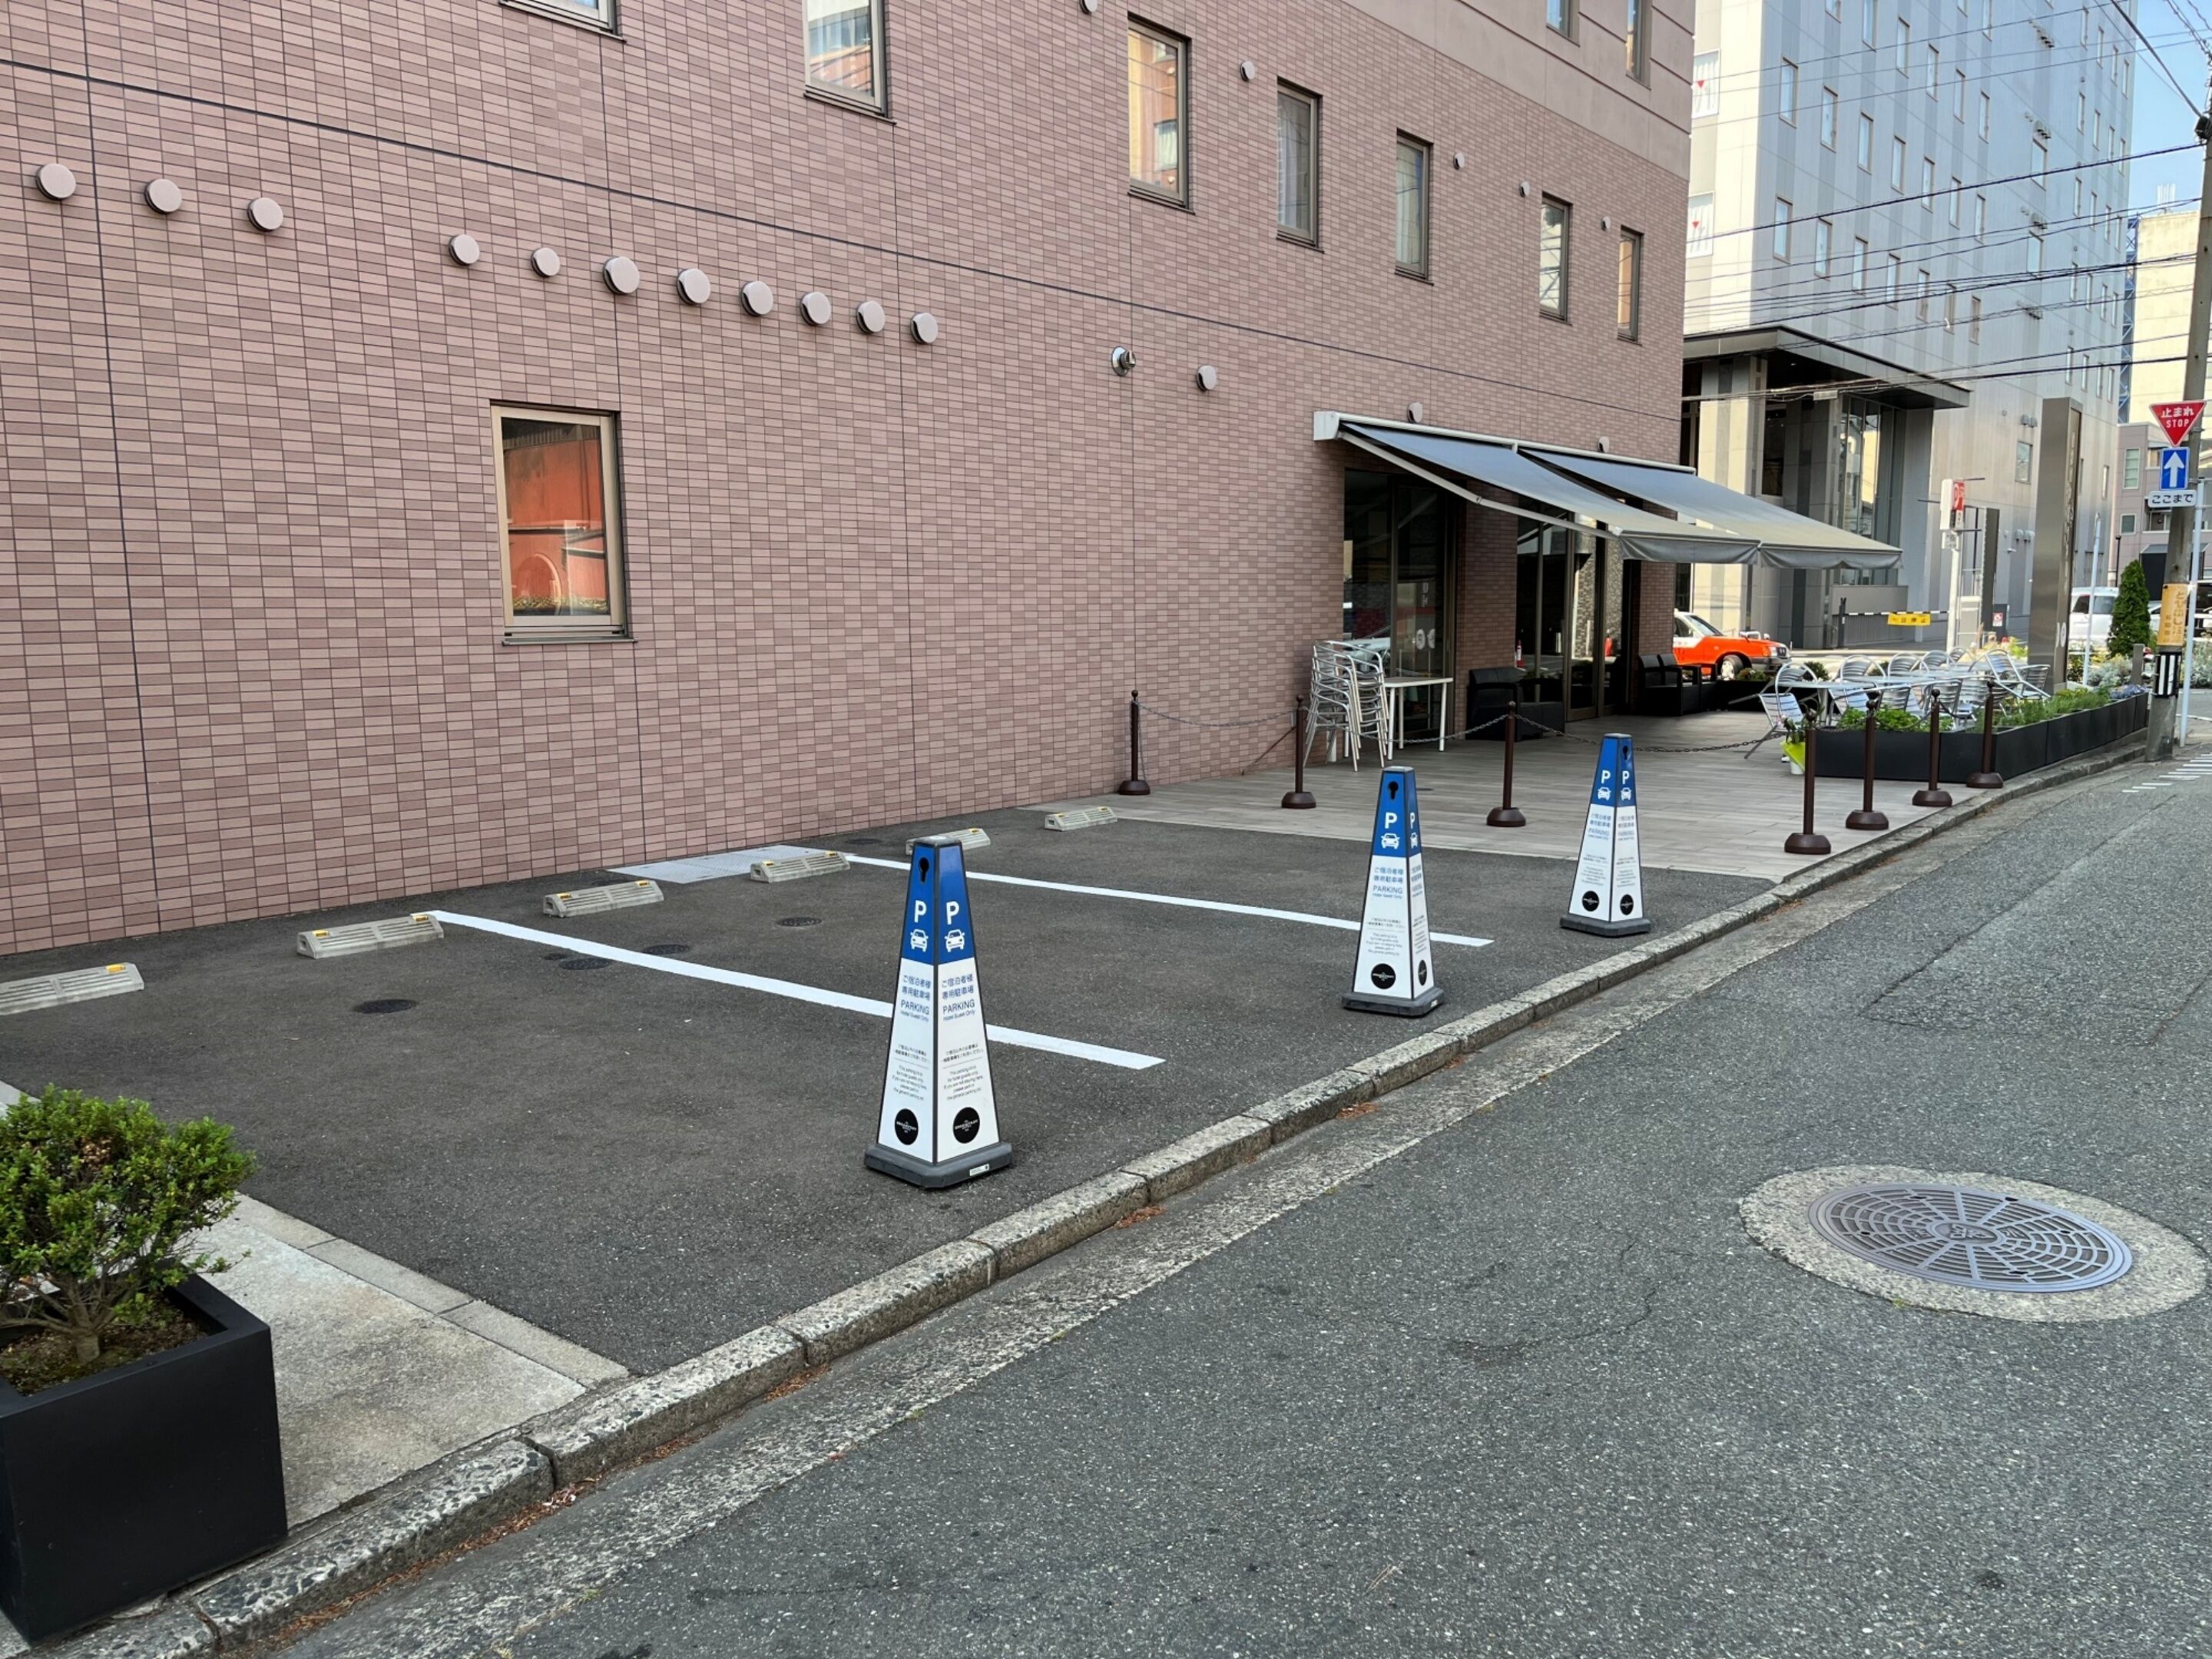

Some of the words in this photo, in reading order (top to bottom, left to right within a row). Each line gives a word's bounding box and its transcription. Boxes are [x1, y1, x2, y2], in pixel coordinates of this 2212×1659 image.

[2161, 406, 2194, 419] 止まれ
[2166, 419, 2190, 429] STOP
[2151, 494, 2194, 504] ここまで
[1601, 770, 1611, 784] P
[1621, 770, 1630, 784] P
[1384, 812, 1398, 830] P
[1409, 812, 1416, 830] P
[1373, 885, 1403, 894] PARKING
[914, 899, 927, 922] P
[945, 901, 959, 925] P
[901, 999, 929, 1015] PARKING
[942, 999, 975, 1014] PARKING
